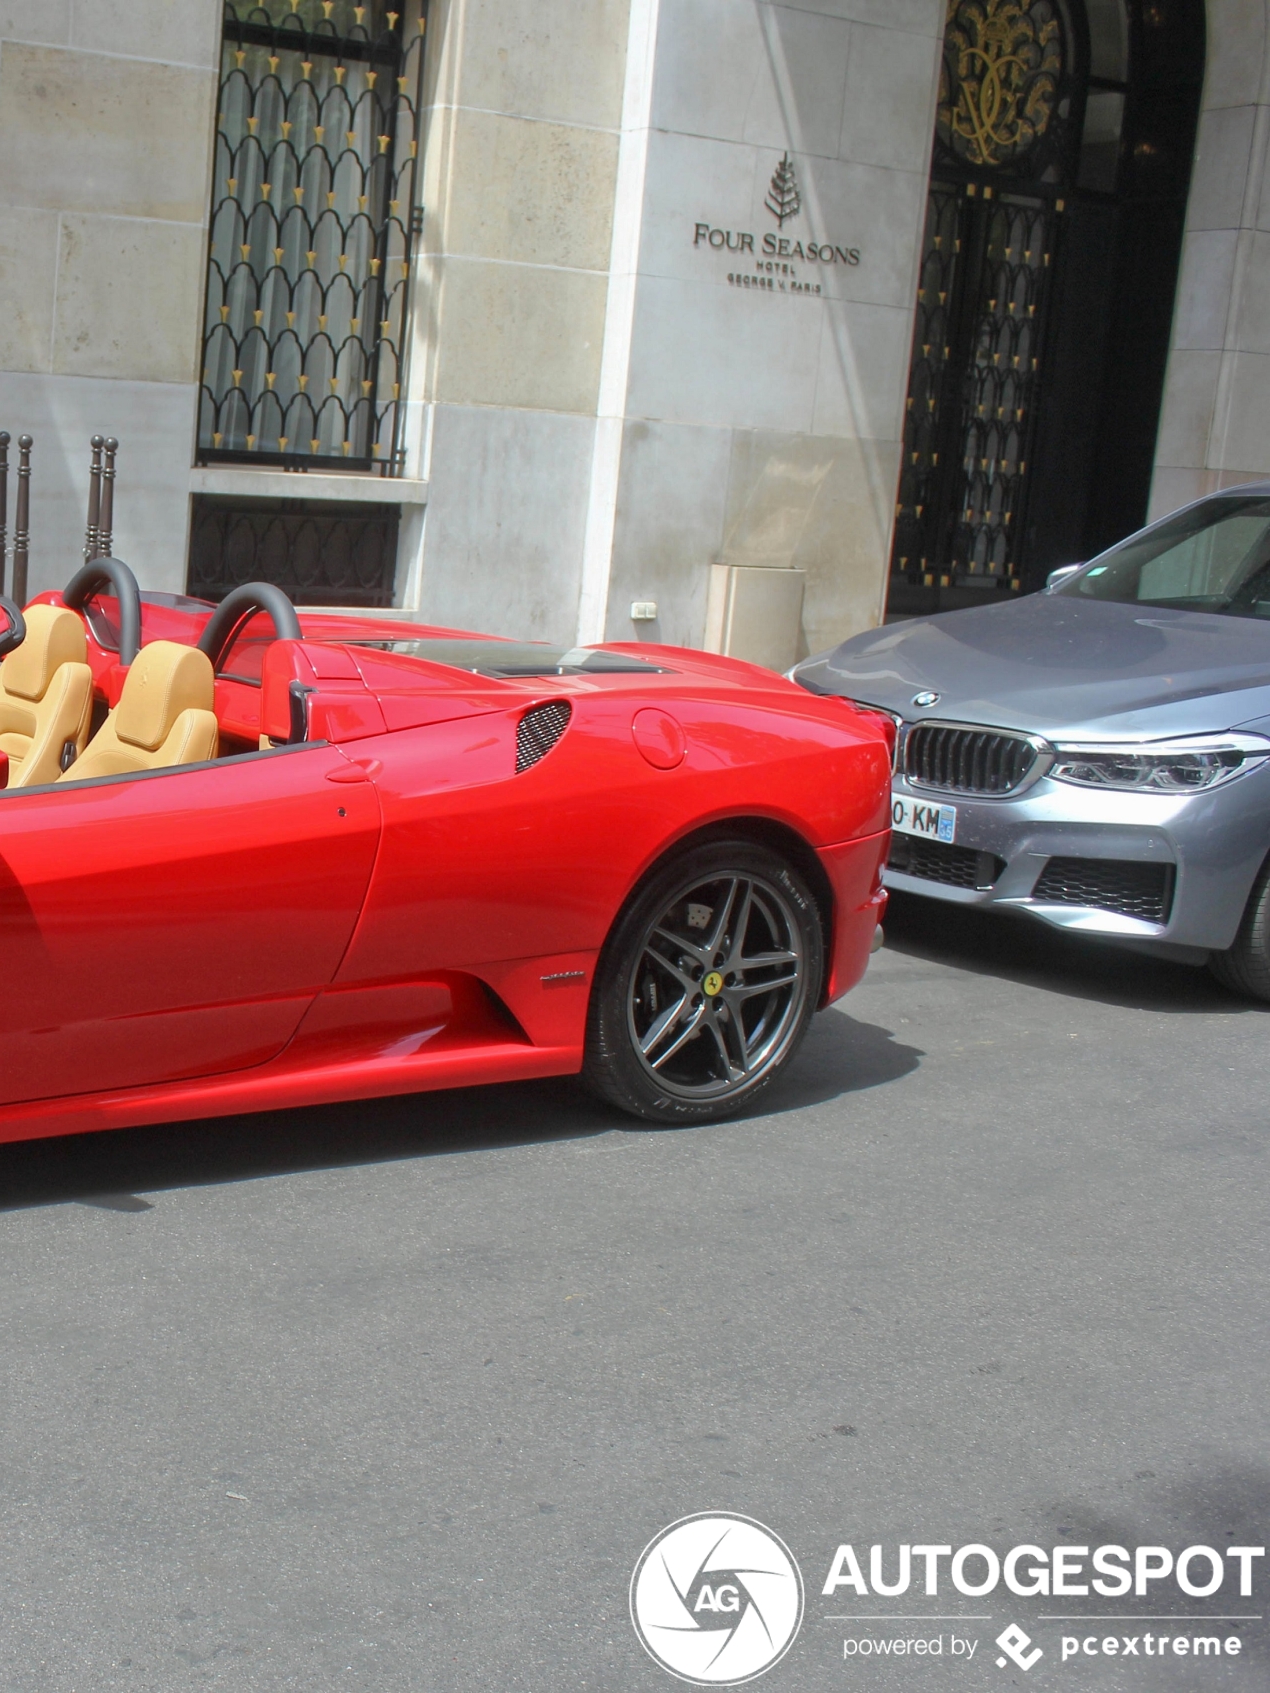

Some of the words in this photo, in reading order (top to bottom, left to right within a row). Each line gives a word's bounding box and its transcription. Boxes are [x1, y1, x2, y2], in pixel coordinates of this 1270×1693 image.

[693, 222, 755, 253] FOUR
[761, 232, 860, 266] SEASONS
[756, 260, 796, 276] HOTEL
[727, 272, 773, 289] GEORGE
[790, 281, 821, 294] PARIS
